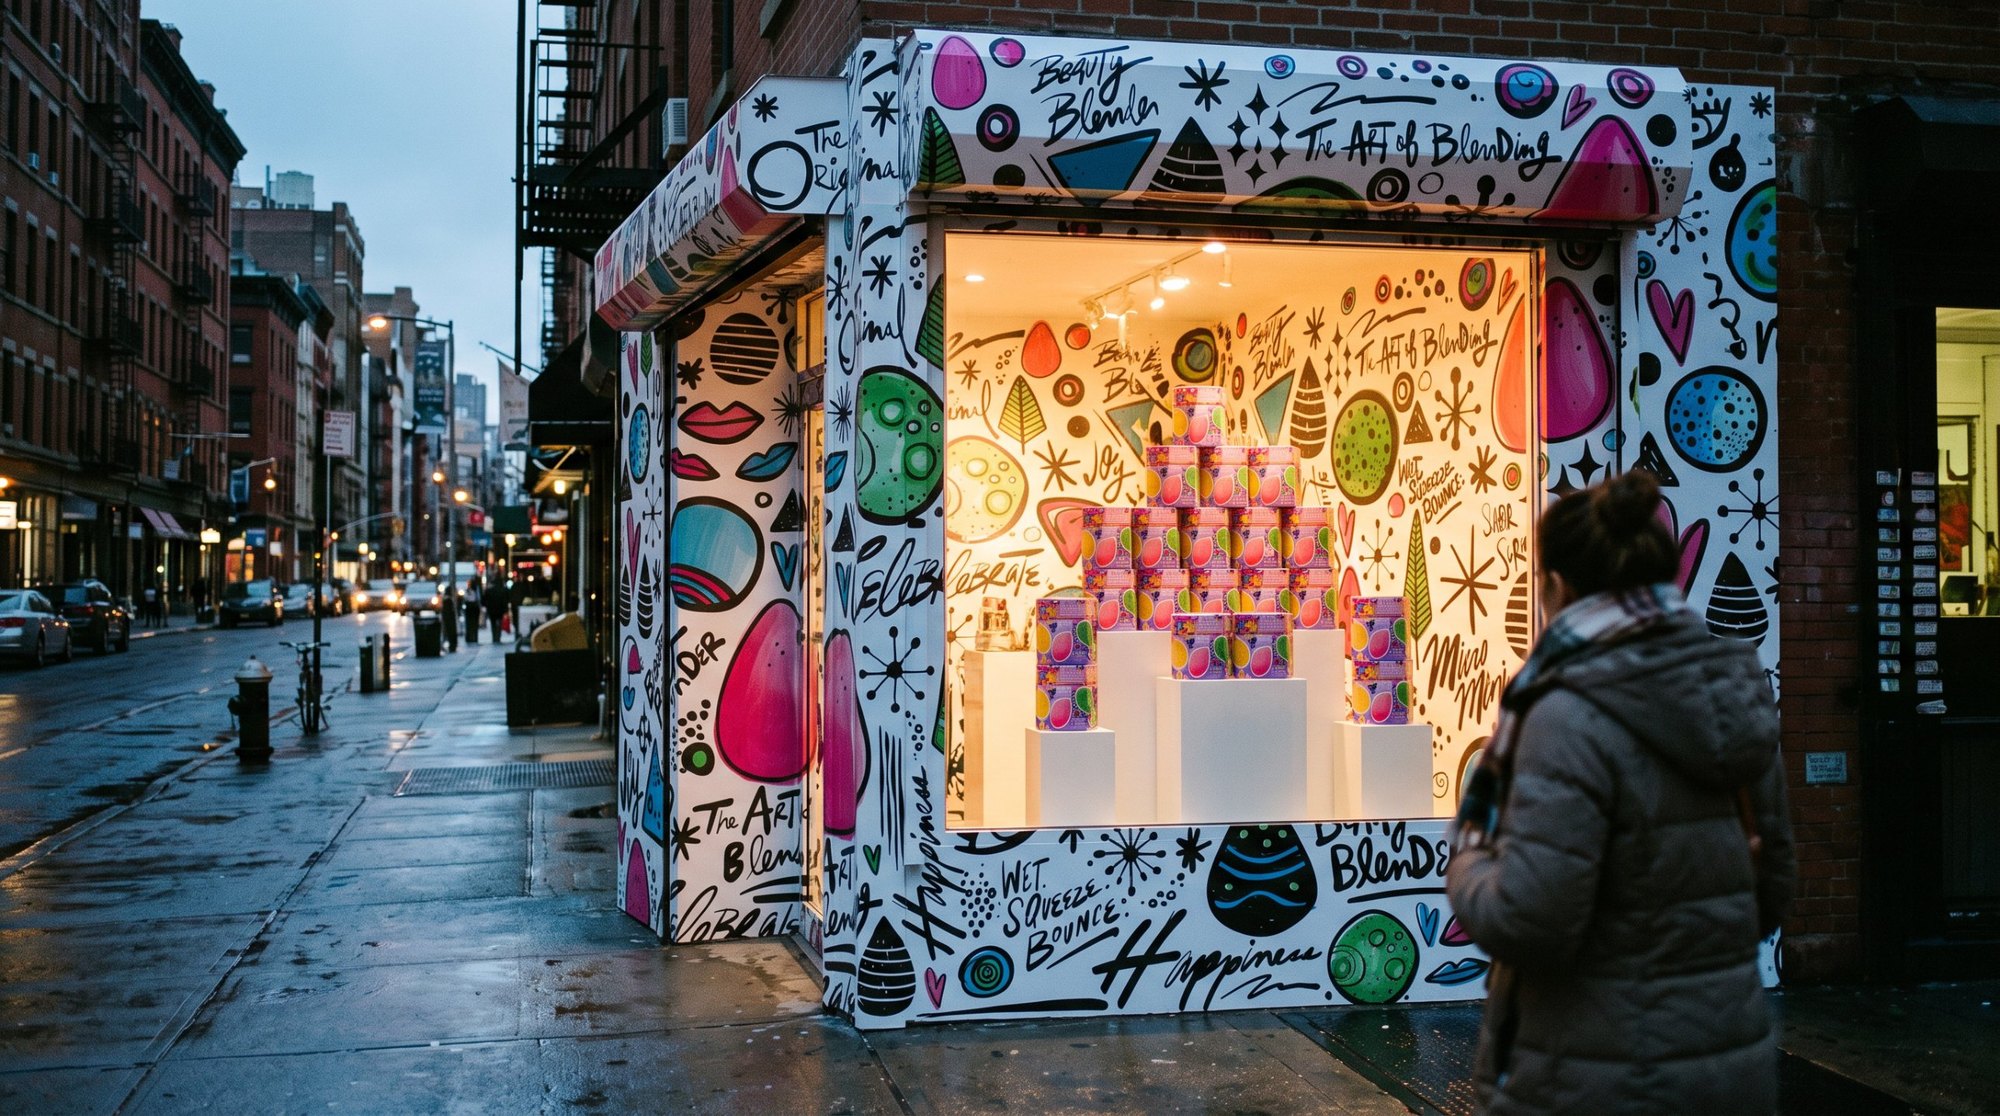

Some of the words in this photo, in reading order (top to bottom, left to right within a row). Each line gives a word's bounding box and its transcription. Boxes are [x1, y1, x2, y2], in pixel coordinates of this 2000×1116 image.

[794, 120, 848, 153] The
[1296, 118, 1337, 162] The
[692, 798, 739, 835] The
[1092, 909, 1322, 1011] Happiness
